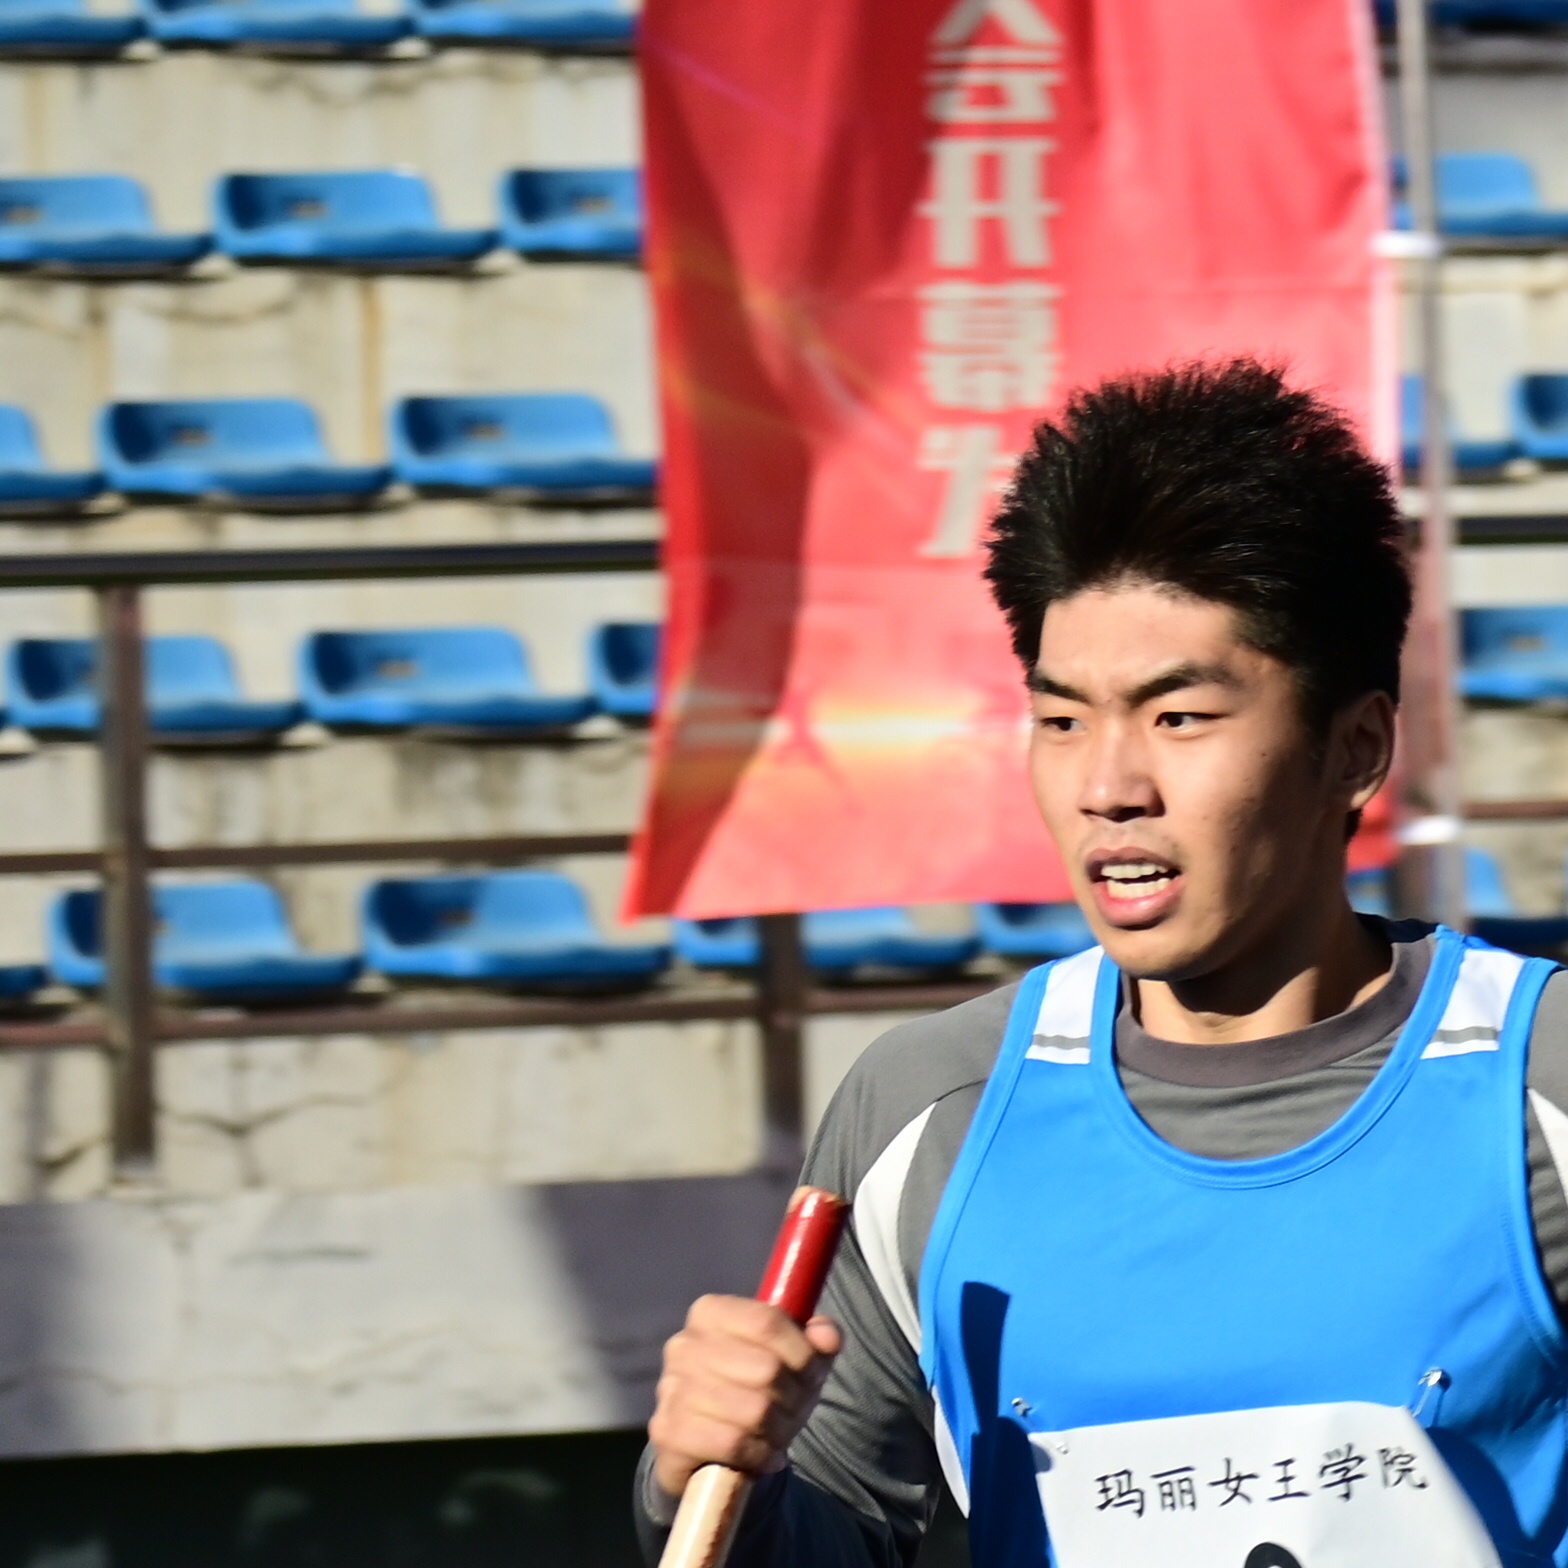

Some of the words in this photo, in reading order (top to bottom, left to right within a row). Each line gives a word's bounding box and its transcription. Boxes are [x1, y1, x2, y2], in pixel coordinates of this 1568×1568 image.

[1095, 1443, 1430, 1519] 玛丽女王学院
